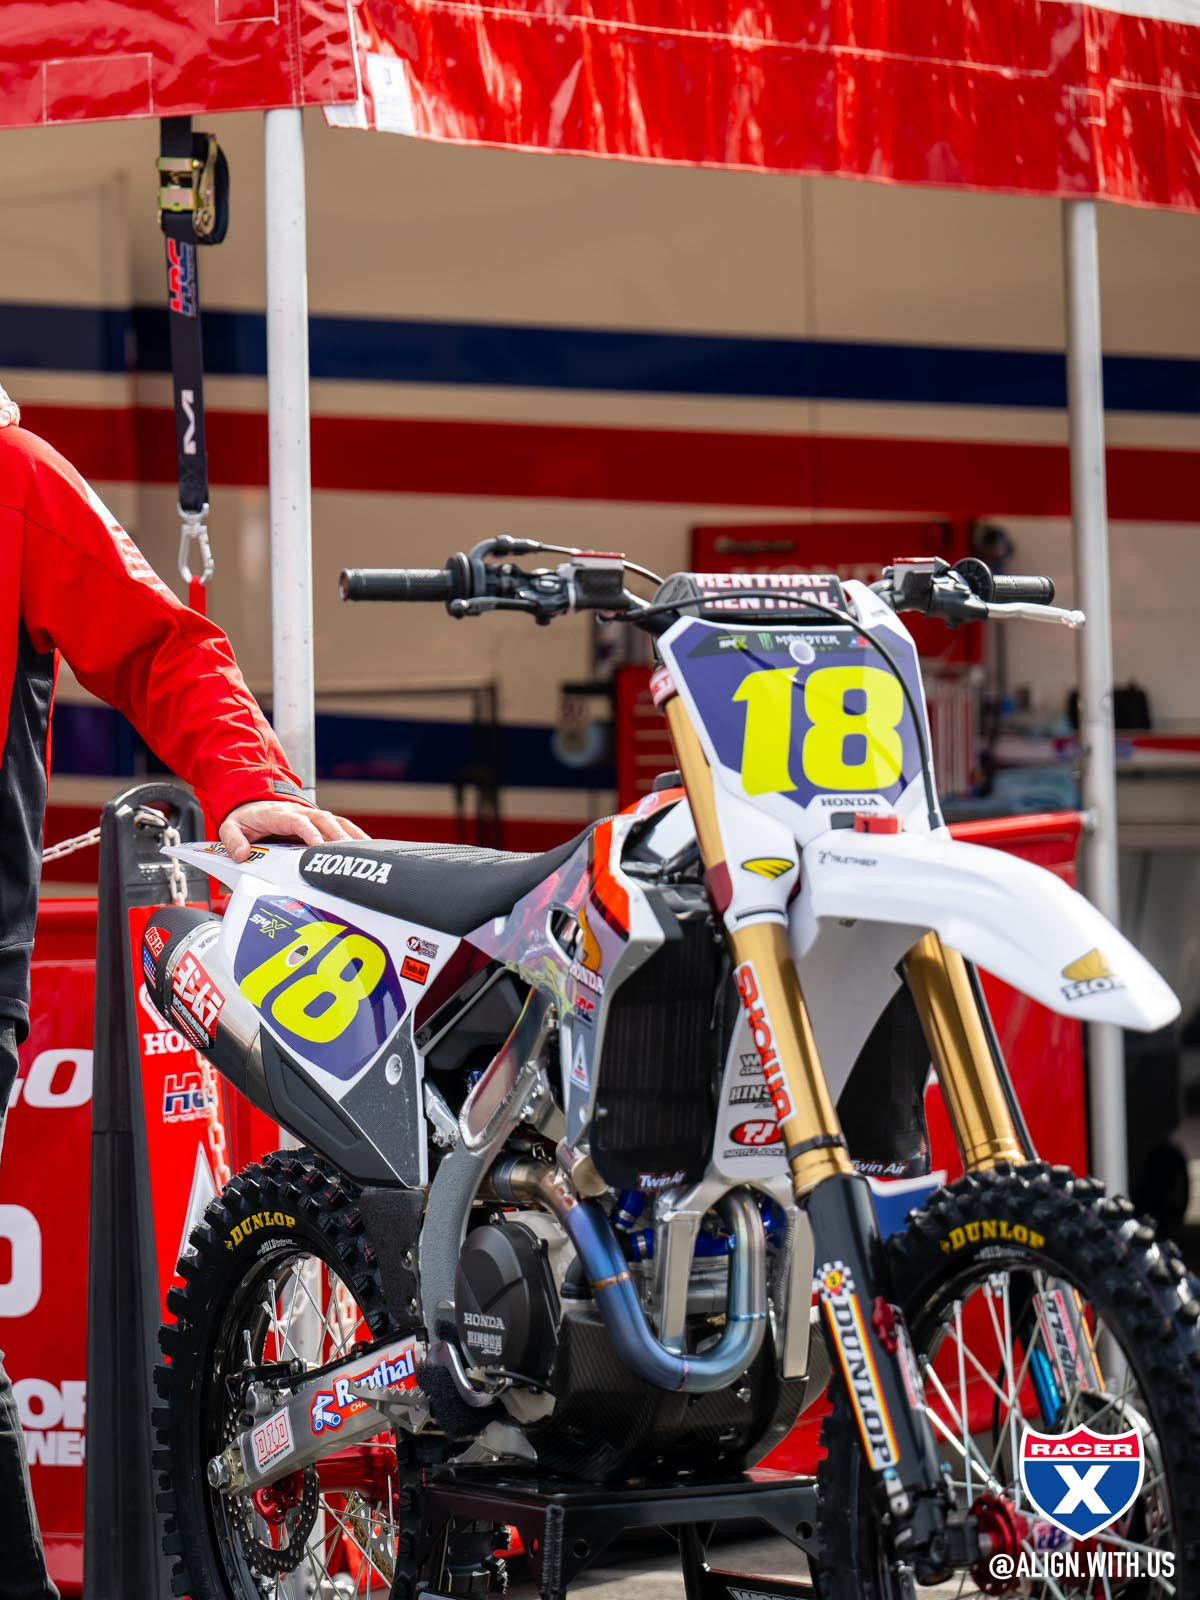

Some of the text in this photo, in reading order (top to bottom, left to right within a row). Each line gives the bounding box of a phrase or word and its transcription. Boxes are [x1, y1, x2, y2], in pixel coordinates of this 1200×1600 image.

[695, 573, 830, 588] RENTHAL
[775, 634, 840, 646] MONSTER
[732, 666, 905, 797] 18
[820, 797, 879, 807] HONDA
[304, 853, 393, 884] HONDA
[249, 913, 287, 939] SMX
[240, 921, 387, 1044] 18
[144, 1030, 194, 1056] HO
[735, 965, 792, 1122] SHOWA
[162, 1071, 216, 1115] HR
[743, 1123, 775, 1143] TJ
[230, 1211, 296, 1247] DUNLOP
[949, 1219, 1046, 1251] DUNLOP
[463, 1312, 506, 1330] HONDA
[335, 1349, 415, 1408] Rnthal
[833, 1299, 892, 1463] DUNLOP
